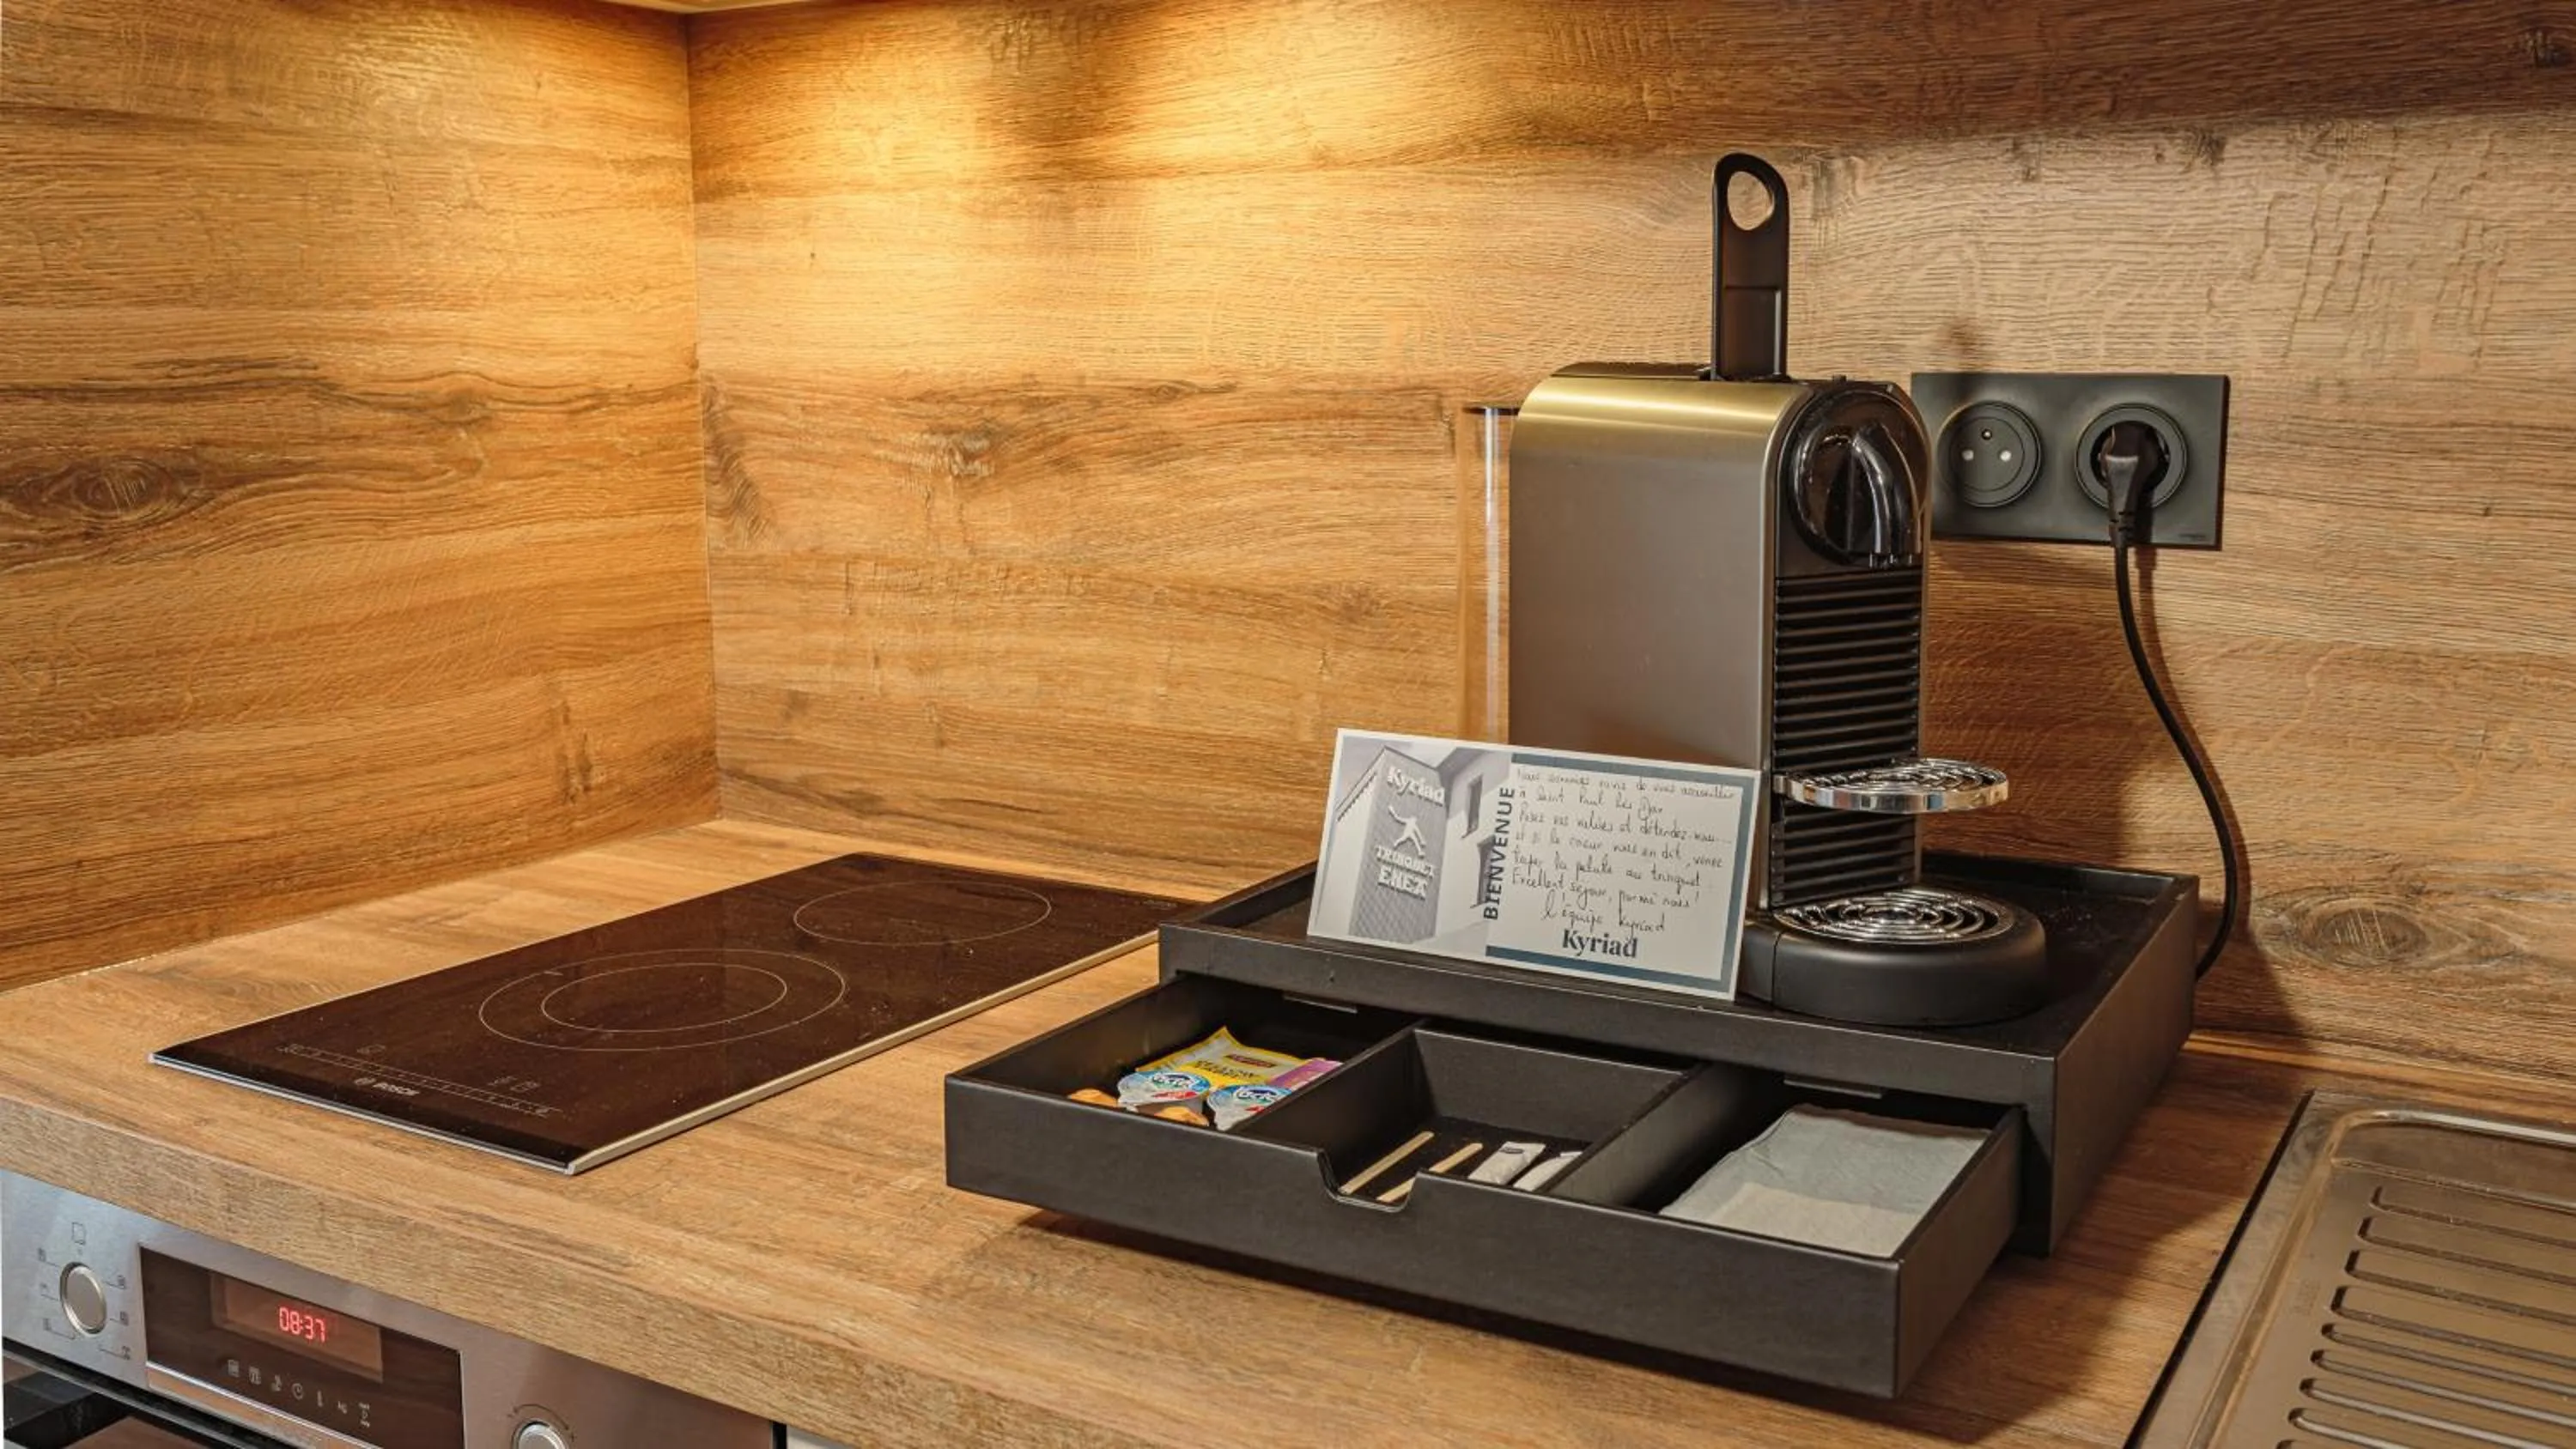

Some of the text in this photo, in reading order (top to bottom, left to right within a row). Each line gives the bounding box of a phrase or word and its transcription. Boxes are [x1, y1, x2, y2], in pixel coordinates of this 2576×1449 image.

[1388, 766, 1444, 805] Kyriad
[1484, 787, 1515, 920] BIENVENUE
[1562, 928, 1637, 958] Kyriad
[278, 1306, 326, 1343] 08:37
